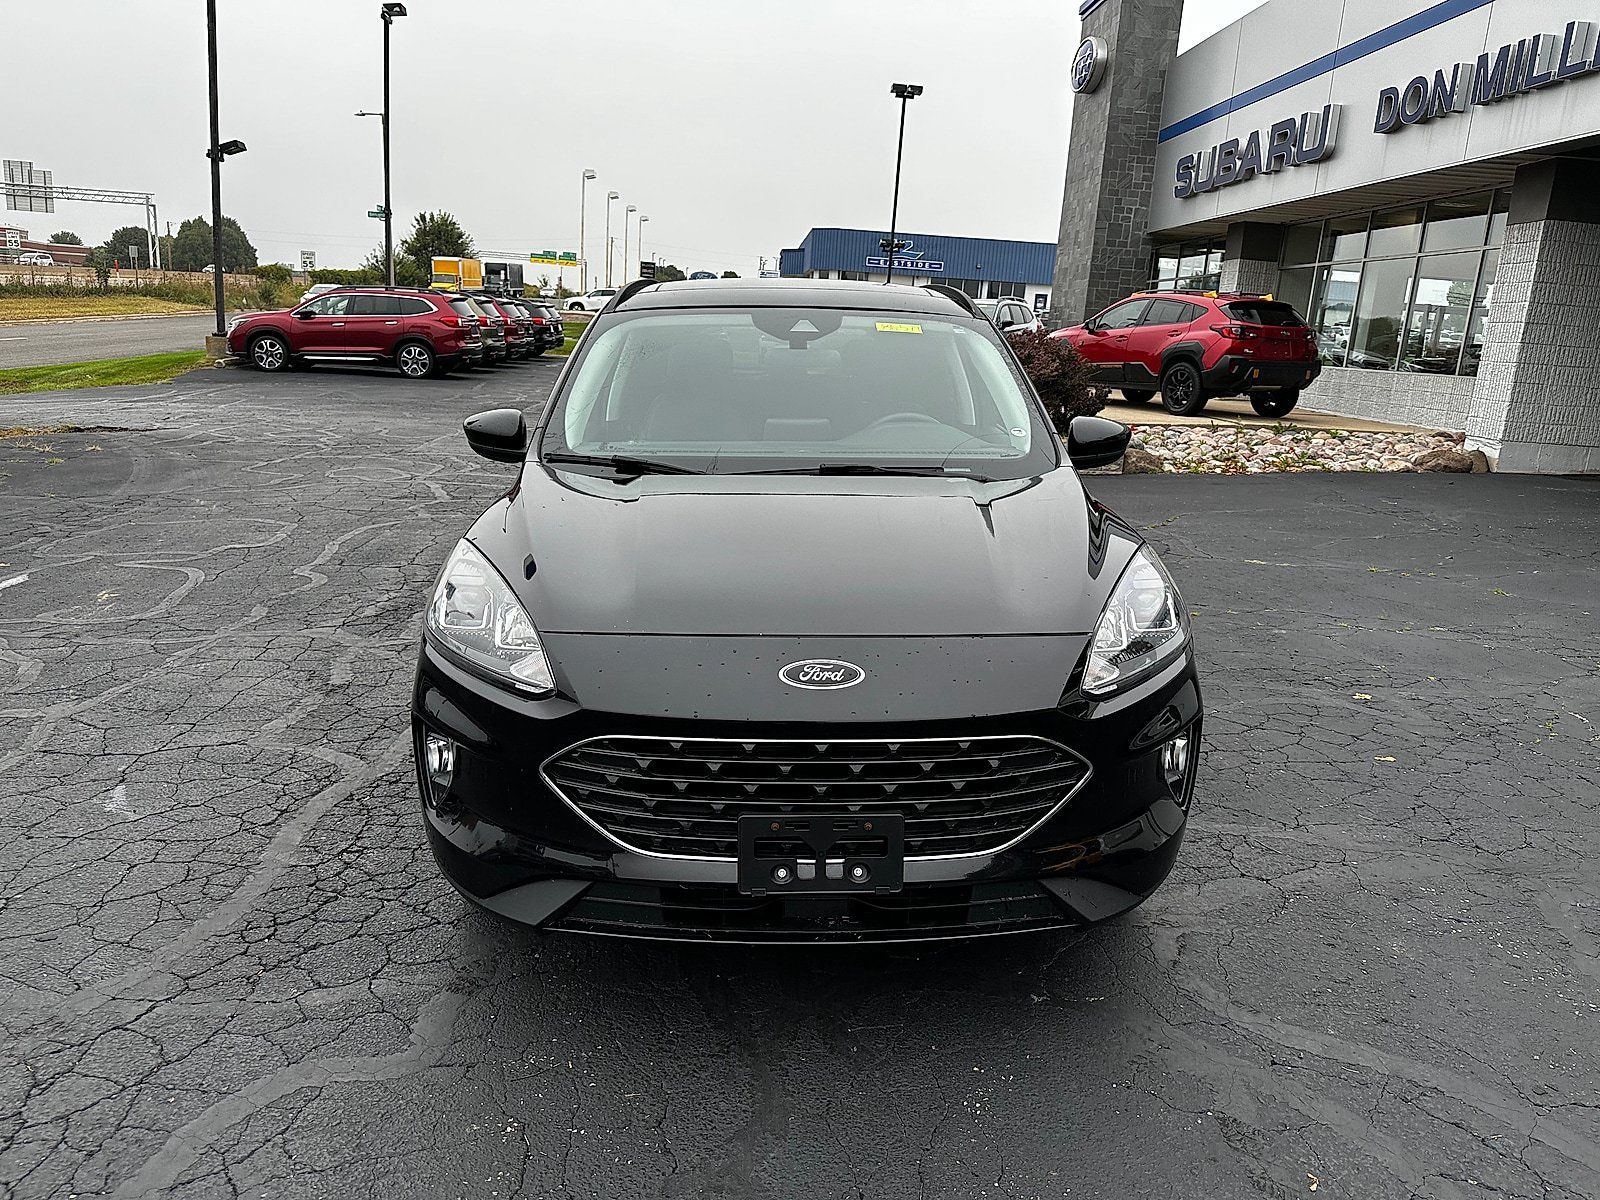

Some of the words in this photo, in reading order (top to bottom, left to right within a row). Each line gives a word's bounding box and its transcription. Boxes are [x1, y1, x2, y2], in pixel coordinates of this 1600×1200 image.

[1373, 62, 1465, 134] DON
[1173, 103, 1337, 199] SUBARU
[799, 664, 846, 682] Ford
